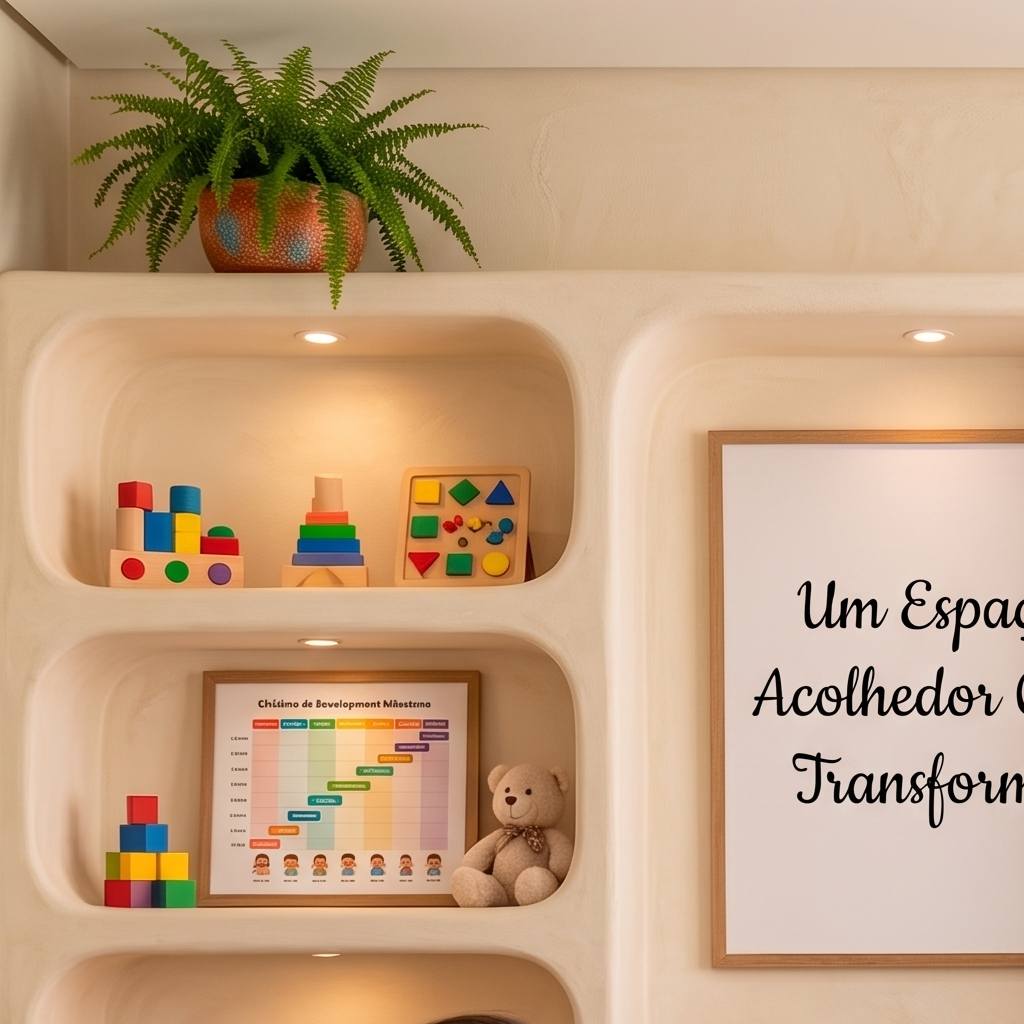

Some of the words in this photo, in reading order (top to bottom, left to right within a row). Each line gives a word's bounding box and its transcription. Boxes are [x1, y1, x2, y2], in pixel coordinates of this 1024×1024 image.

[797, 580, 888, 629] Um
[301, 699, 313, 708] de
[752, 666, 1003, 716] Acolhedor
